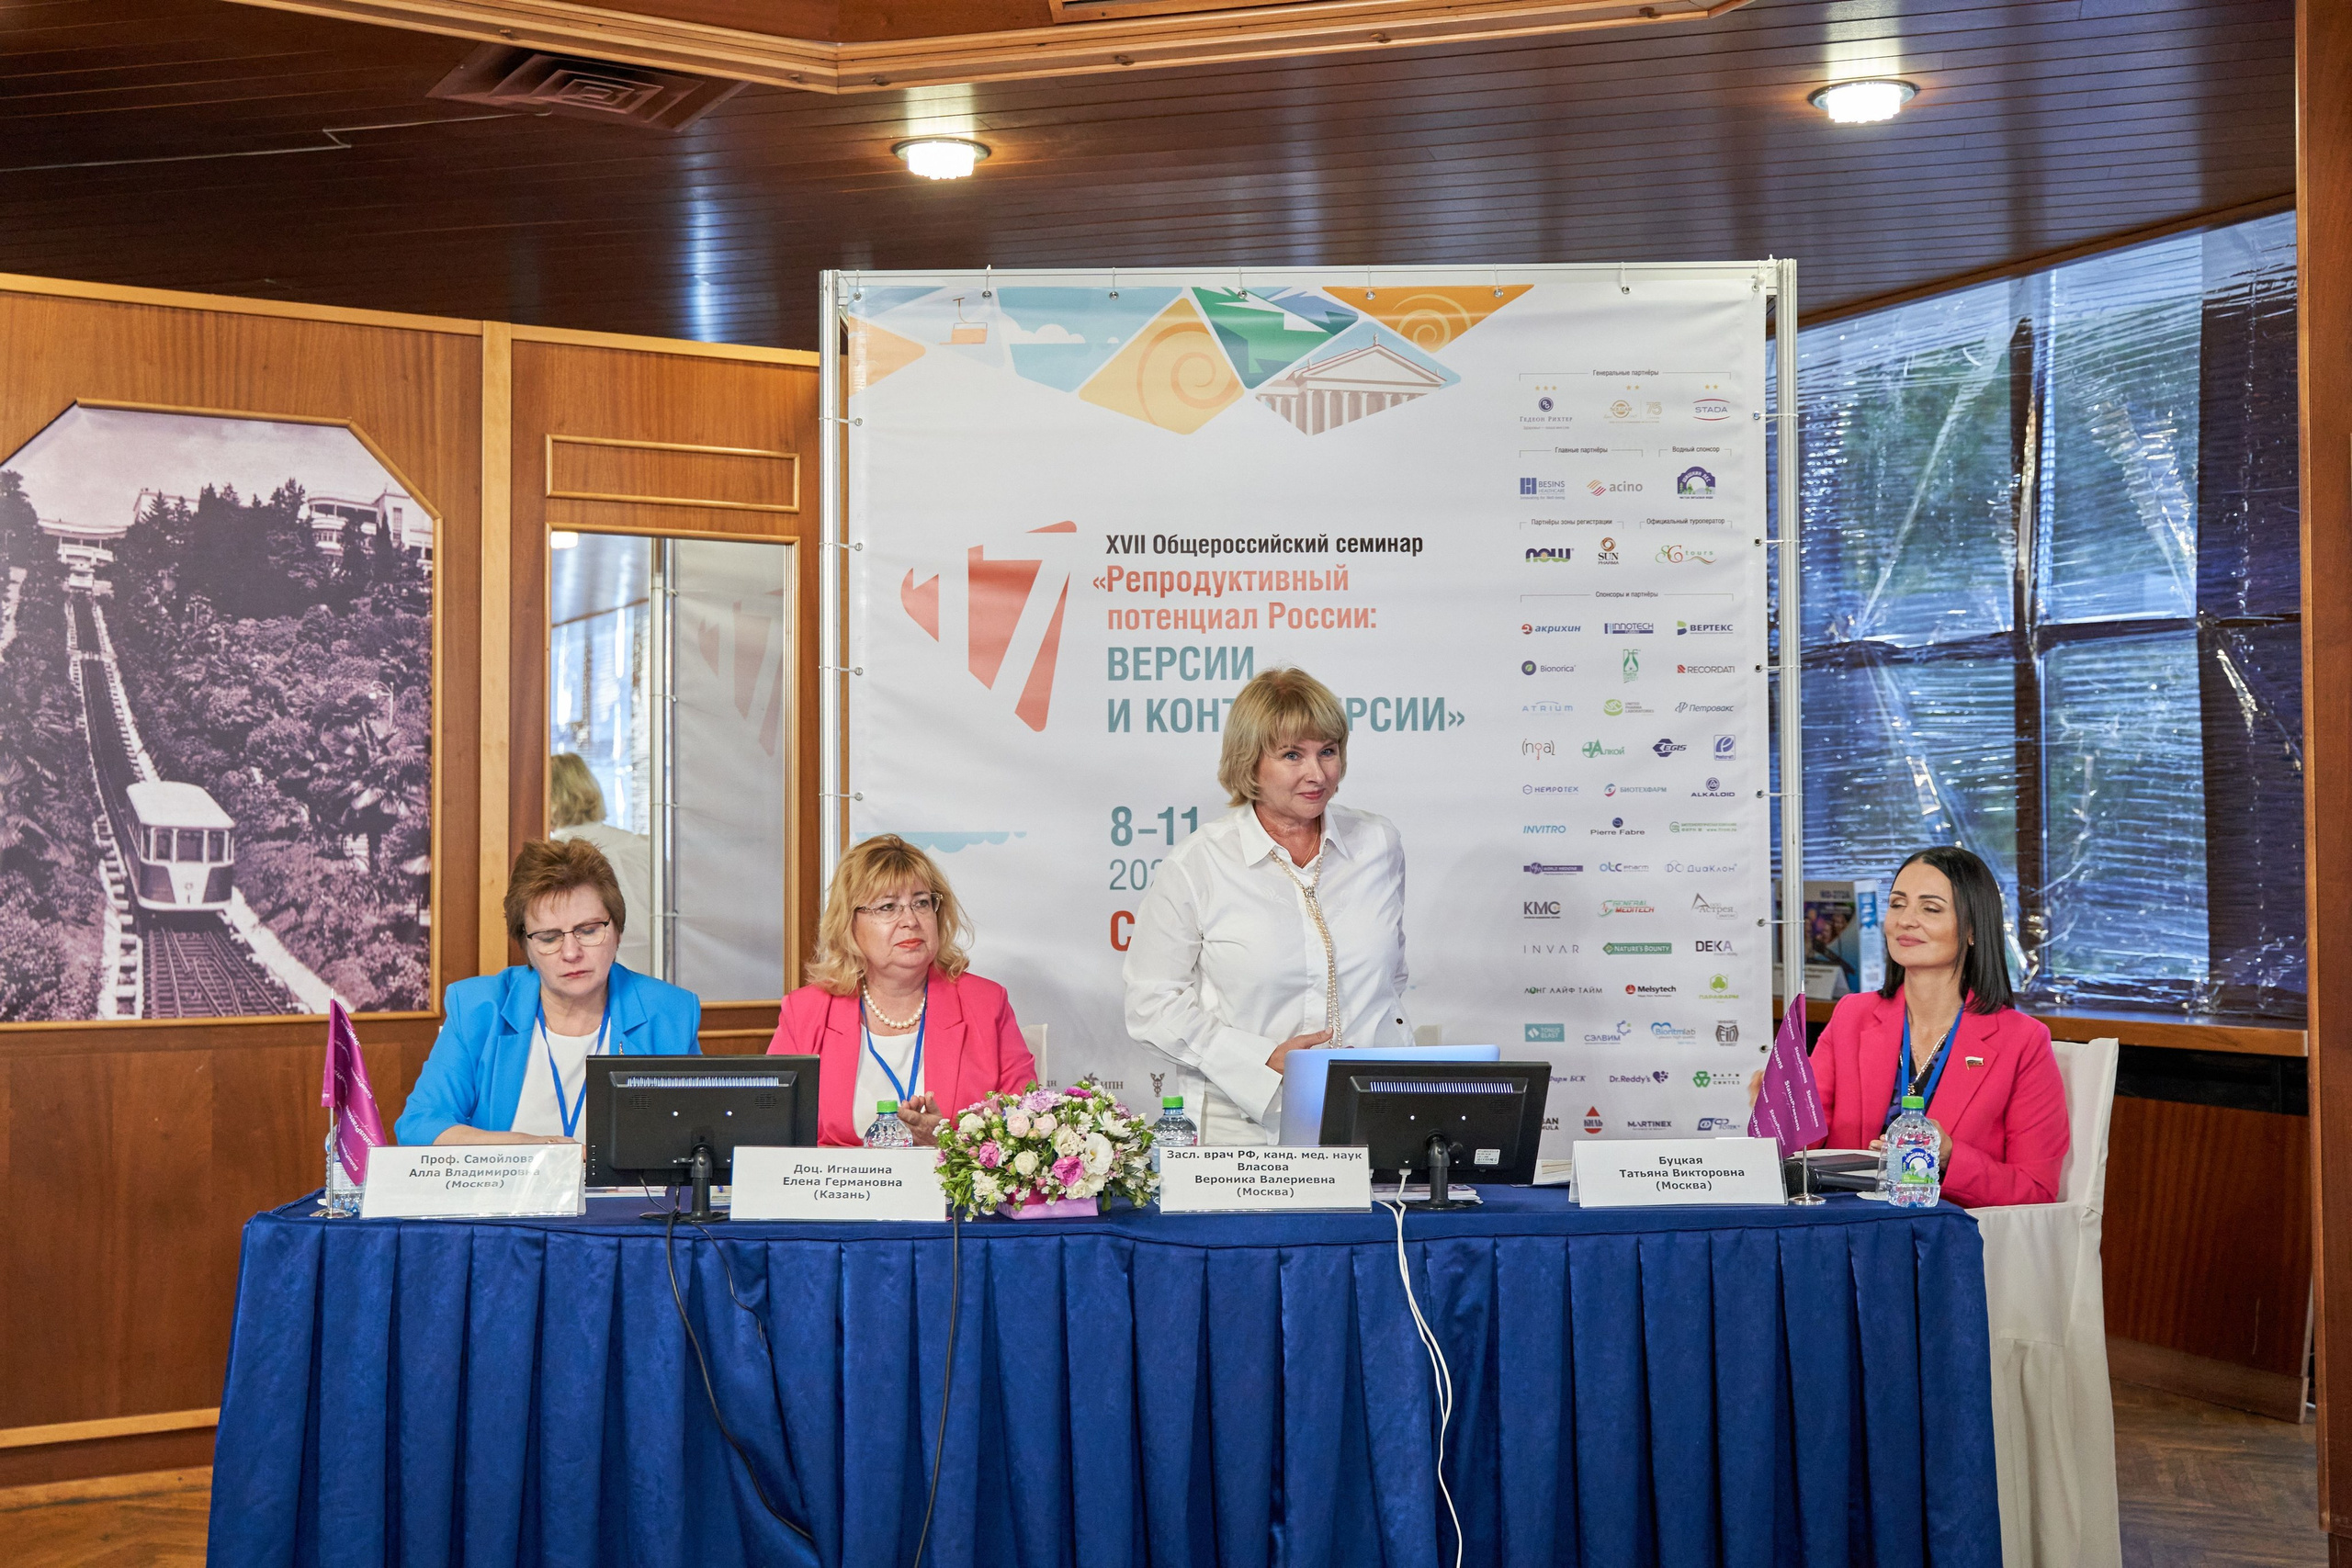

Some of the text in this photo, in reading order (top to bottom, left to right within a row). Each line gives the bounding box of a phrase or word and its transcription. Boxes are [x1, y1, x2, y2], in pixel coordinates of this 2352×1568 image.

[1672, 446, 1695, 454] Водный
[1538, 480, 1566, 489] BESINS
[1609, 480, 1643, 492] acino
[1646, 517, 1689, 526] Официальный
[1105, 534, 1423, 558] XVII Общероссийский семинар
[1598, 552, 1619, 560] SUN
[1093, 564, 1349, 598] «Репродуктивный
[1595, 591, 1624, 599] Спонсоры
[1631, 591, 1658, 599] партнёры
[1108, 602, 1377, 634] потенциал России:
[1534, 625, 1581, 634] акрихин
[1690, 624, 1734, 632] ВЕРТЕКС
[1108, 646, 1255, 681] ВЕРСИИ
[1687, 665, 1735, 673] RECORDATI
[1689, 704, 1735, 713] Петровакс
[1108, 699, 1131, 733] И
[1523, 825, 1566, 834] INVITRO
[1695, 941, 1733, 952] DEKA
[1549, 986, 1576, 995] ЛАЙФ
[1578, 986, 1602, 994] ТАЙМ
[1637, 985, 1677, 994] Melsytech
[1794, 1046, 1808, 1084] StatusPraesens
[1784, 1079, 1801, 1132] StatusPraesens
[1806, 1089, 1819, 1128] StatusPraesens
[1769, 1109, 1786, 1146] StatusPraesens
[421, 1154, 535, 1166] Проф. Самойлова
[1167, 1150, 1363, 1161] Засл. врач РФ, канд. мед. наук
[1238, 1162, 1289, 1172] Власова
[1659, 1156, 1703, 1167] Буцкая
[409, 1168, 541, 1179] Алла Владимировна
[794, 1164, 893, 1176] Доц. Игнашина
[1619, 1168, 1745, 1179] Татьяна Викторовна
[445, 1179, 505, 1190] (Москва)
[783, 1177, 903, 1188] Елена Германовна
[1194, 1175, 1336, 1186] Вероника Валериевна
[1656, 1180, 1713, 1191] (Москва)
[813, 1190, 871, 1201] (Казань)
[1237, 1187, 1295, 1198] (Москва)
